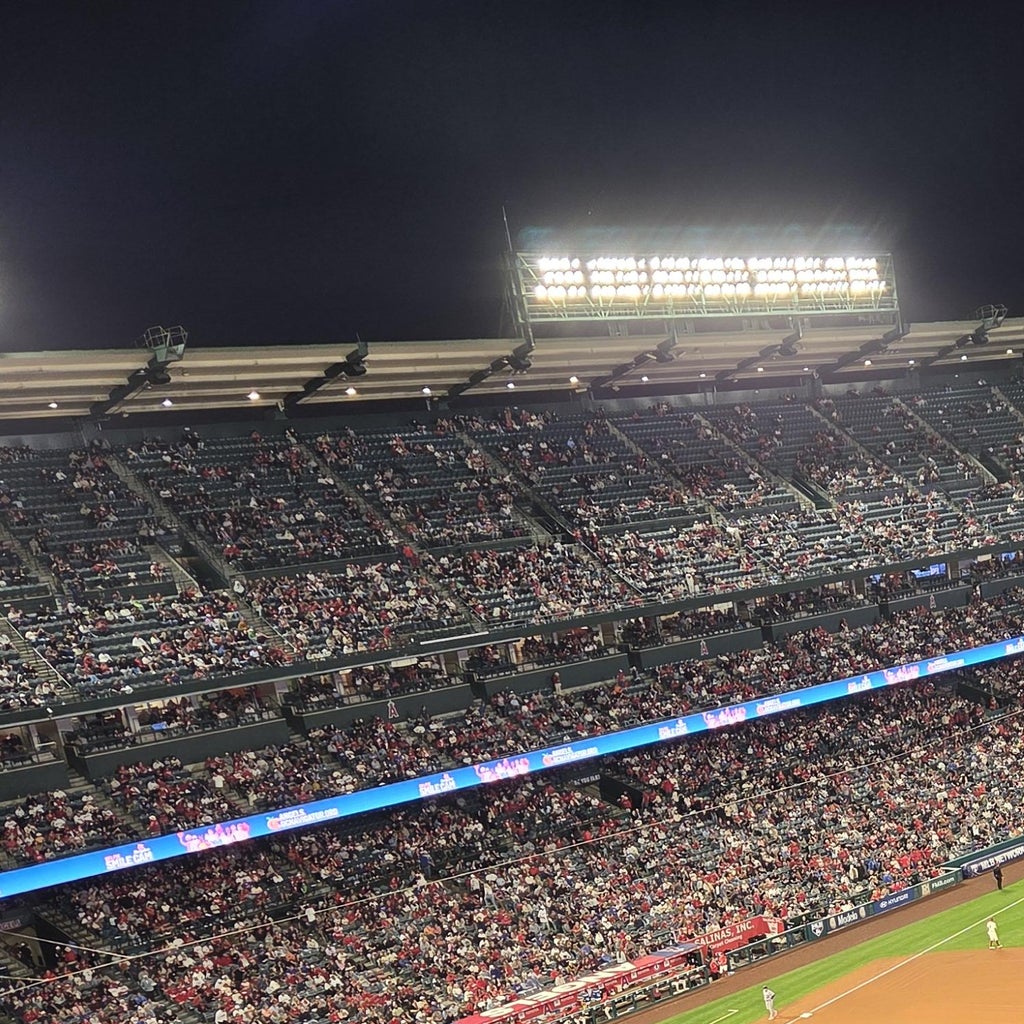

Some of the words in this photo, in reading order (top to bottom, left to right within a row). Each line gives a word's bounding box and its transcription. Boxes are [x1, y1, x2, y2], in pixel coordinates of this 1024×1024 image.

[981, 858, 996, 870] MLB
[837, 911, 858, 926] Modelo
[694, 928, 735, 946] SALINAS,
[736, 920, 755, 934] INC.
